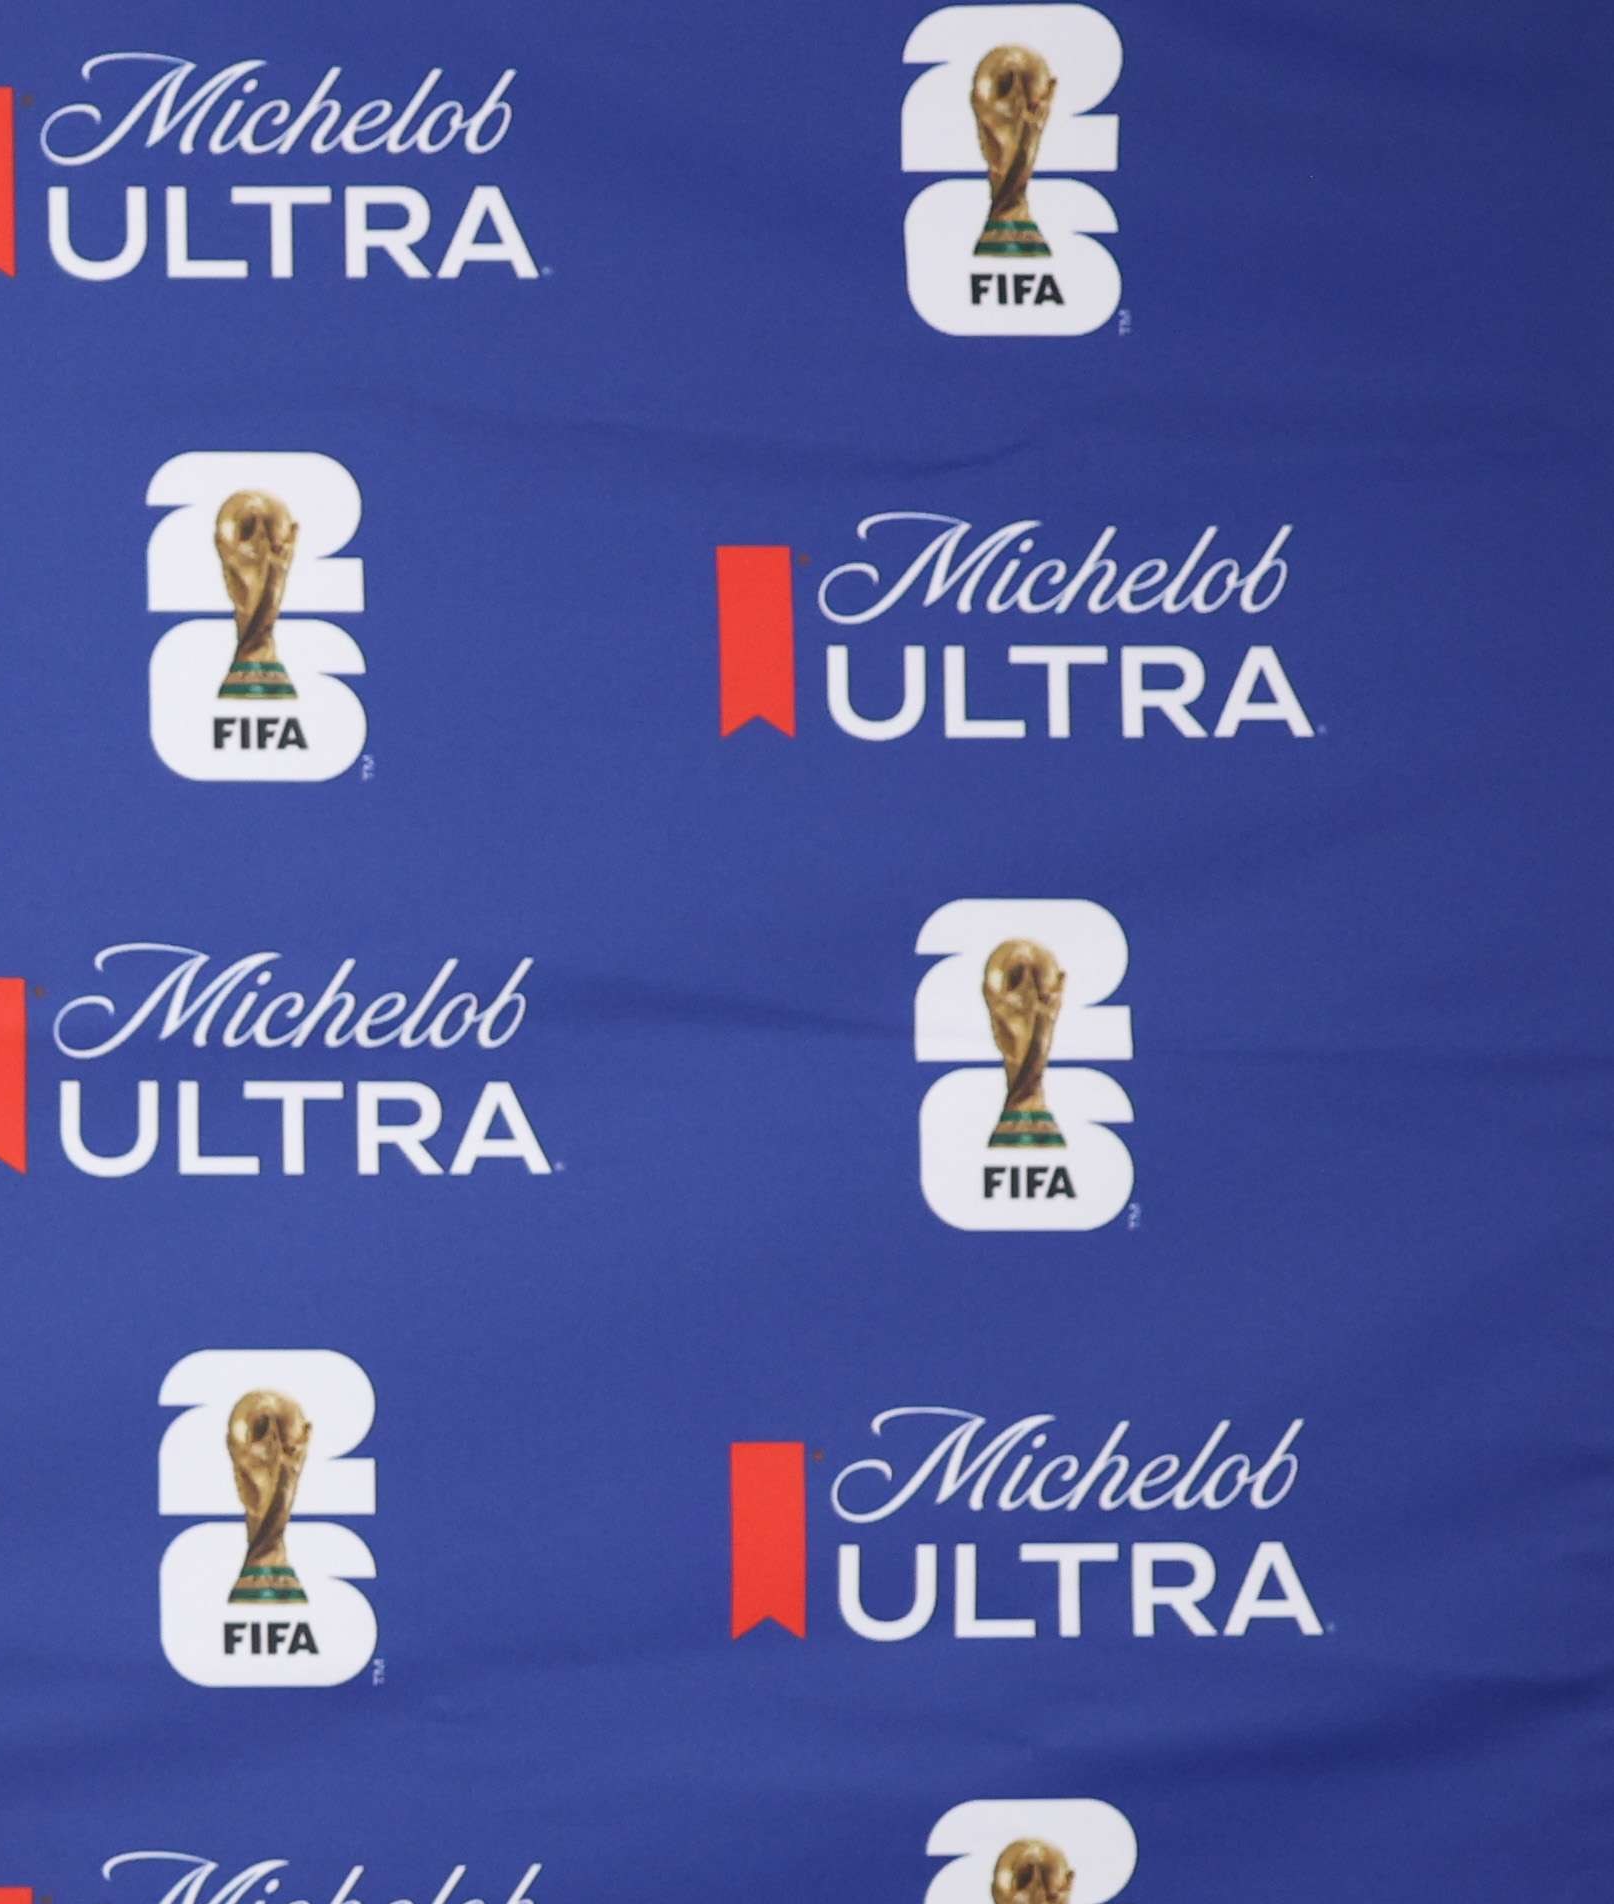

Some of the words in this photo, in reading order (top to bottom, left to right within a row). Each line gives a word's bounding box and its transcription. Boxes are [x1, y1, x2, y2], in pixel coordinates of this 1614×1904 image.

[40, 52, 516, 166] Michelob
[47, 185, 539, 282] ULTRA
[970, 273, 1064, 305] FIFA
[818, 511, 1292, 625] Michelob
[213, 717, 307, 750] FIFA
[826, 644, 1315, 742] ULTRA
[53, 942, 534, 1059] Michelob
[59, 1079, 552, 1178] ULTRA
[983, 1166, 1076, 1199] FIFA
[830, 1406, 1304, 1524] Michelob
[224, 1622, 319, 1655] FIFA
[838, 1541, 1324, 1642] ULTRA
